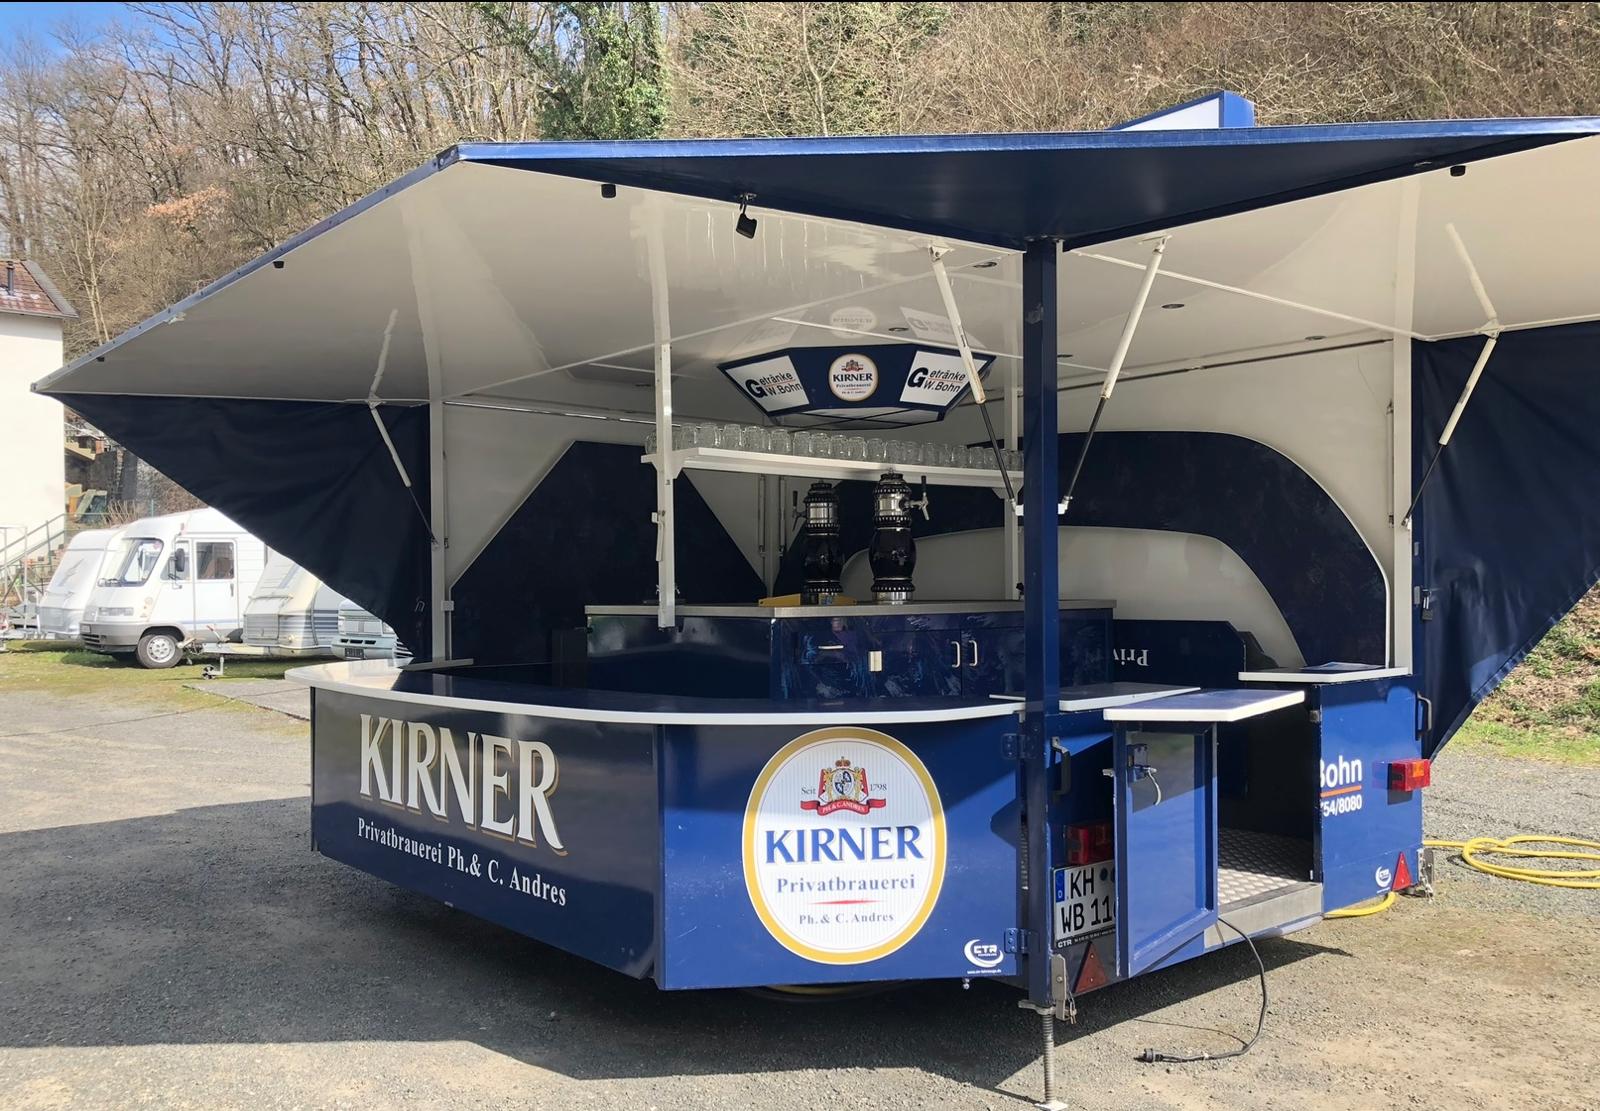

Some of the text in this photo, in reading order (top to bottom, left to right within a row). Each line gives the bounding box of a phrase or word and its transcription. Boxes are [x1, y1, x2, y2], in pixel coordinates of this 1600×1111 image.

[745, 372, 793, 398] Getränke
[833, 373, 873, 382] KIRNER
[907, 367, 966, 388] Getränke
[360, 713, 566, 852] KIRNER
[801, 783, 888, 795] Seit 1798
[1320, 794, 1363, 817] 54/8080
[765, 825, 924, 864] KIRNER
[358, 816, 443, 864] Privatbrauerei
[488, 859, 504, 886] C.
[509, 866, 566, 906] Andres
[777, 874, 915, 893] Privatbrauerei
[1070, 867, 1094, 899] KH
[851, 911, 894, 922] Andres
[1061, 896, 1117, 934] WB 11
[1057, 939, 1073, 949] CTR
